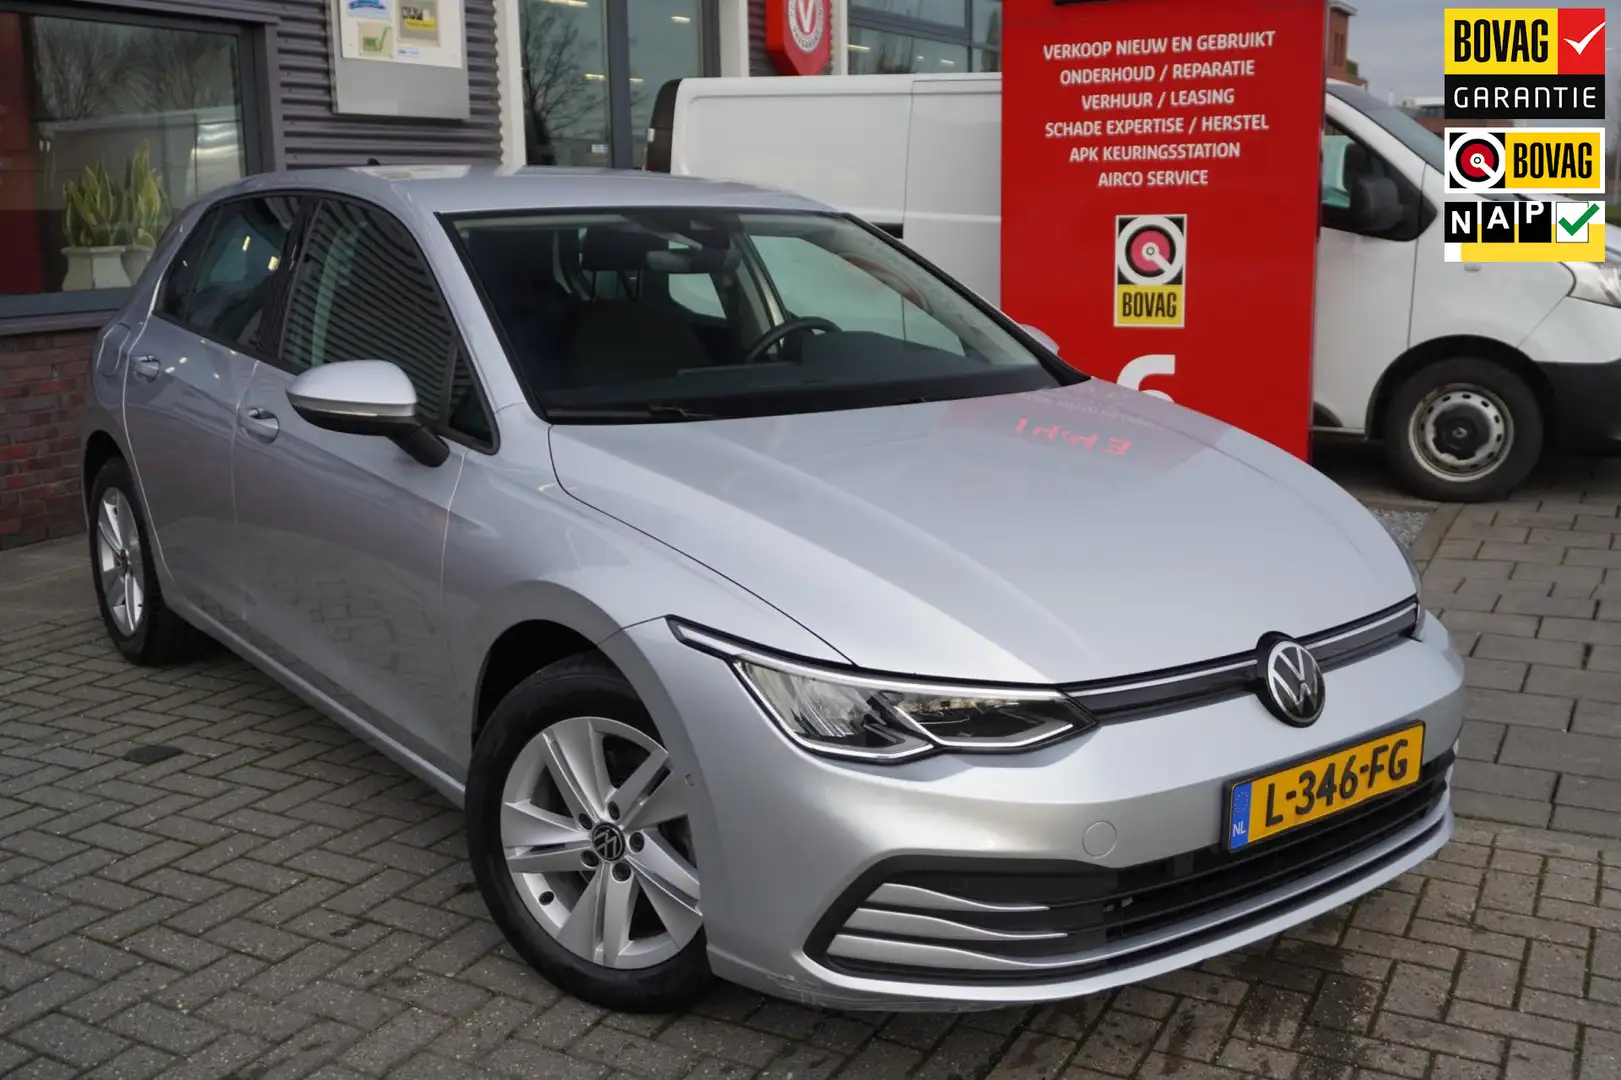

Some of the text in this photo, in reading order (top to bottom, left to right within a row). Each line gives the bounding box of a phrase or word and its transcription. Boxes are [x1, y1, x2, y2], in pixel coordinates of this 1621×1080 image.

[1043, 31, 1276, 60] VERKOOP NIEUW EN GEBRUIKT
[1060, 65, 1155, 85] ONDERHOUD
[1172, 60, 1255, 79] REPARATIE
[1082, 92, 1153, 110] VERHUUR
[1170, 88, 1234, 107] LEASING
[1045, 121, 1102, 138] SCHADE
[1106, 117, 1184, 136] EXPERTISE
[1202, 114, 1269, 132] HERSTEL
[1069, 142, 1240, 162] APK KEURINGSSTATION
[1098, 169, 1209, 187] AIRCO SERVICE
[1122, 291, 1177, 318] BOVAG
[1265, 739, 1408, 828] L-346-FG
[1232, 823, 1246, 837] NL
